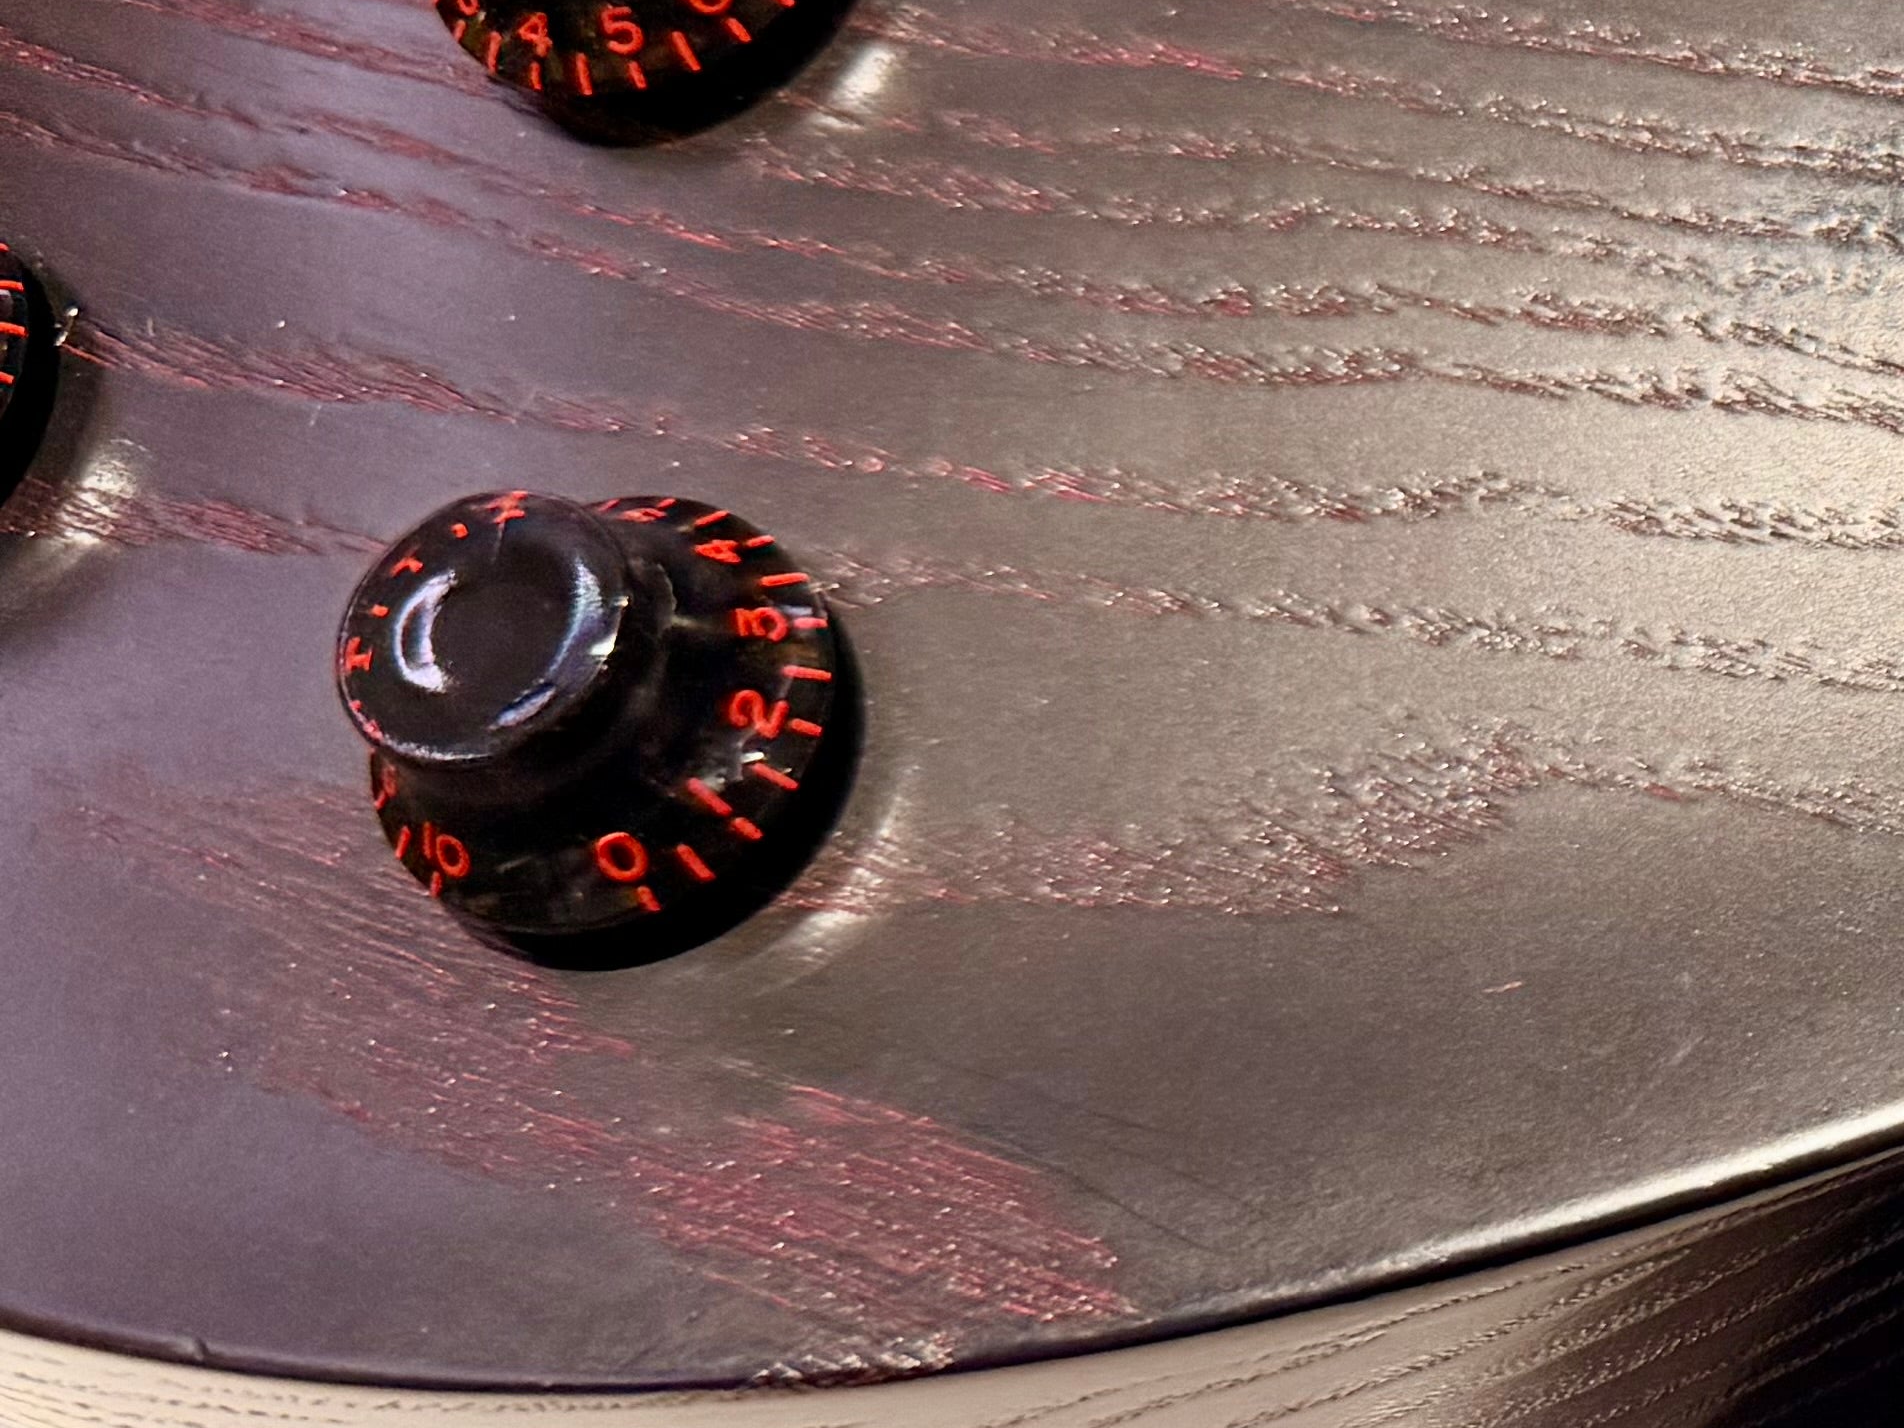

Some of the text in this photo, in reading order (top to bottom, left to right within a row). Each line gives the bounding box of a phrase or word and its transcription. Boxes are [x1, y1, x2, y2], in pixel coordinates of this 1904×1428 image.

[518, 12, 553, 58] 4
[601, 5, 644, 55] 5
[734, 607, 789, 642] 3
[728, 689, 789, 740] 2
[422, 821, 470, 878] 10
[596, 831, 649, 883] 0
